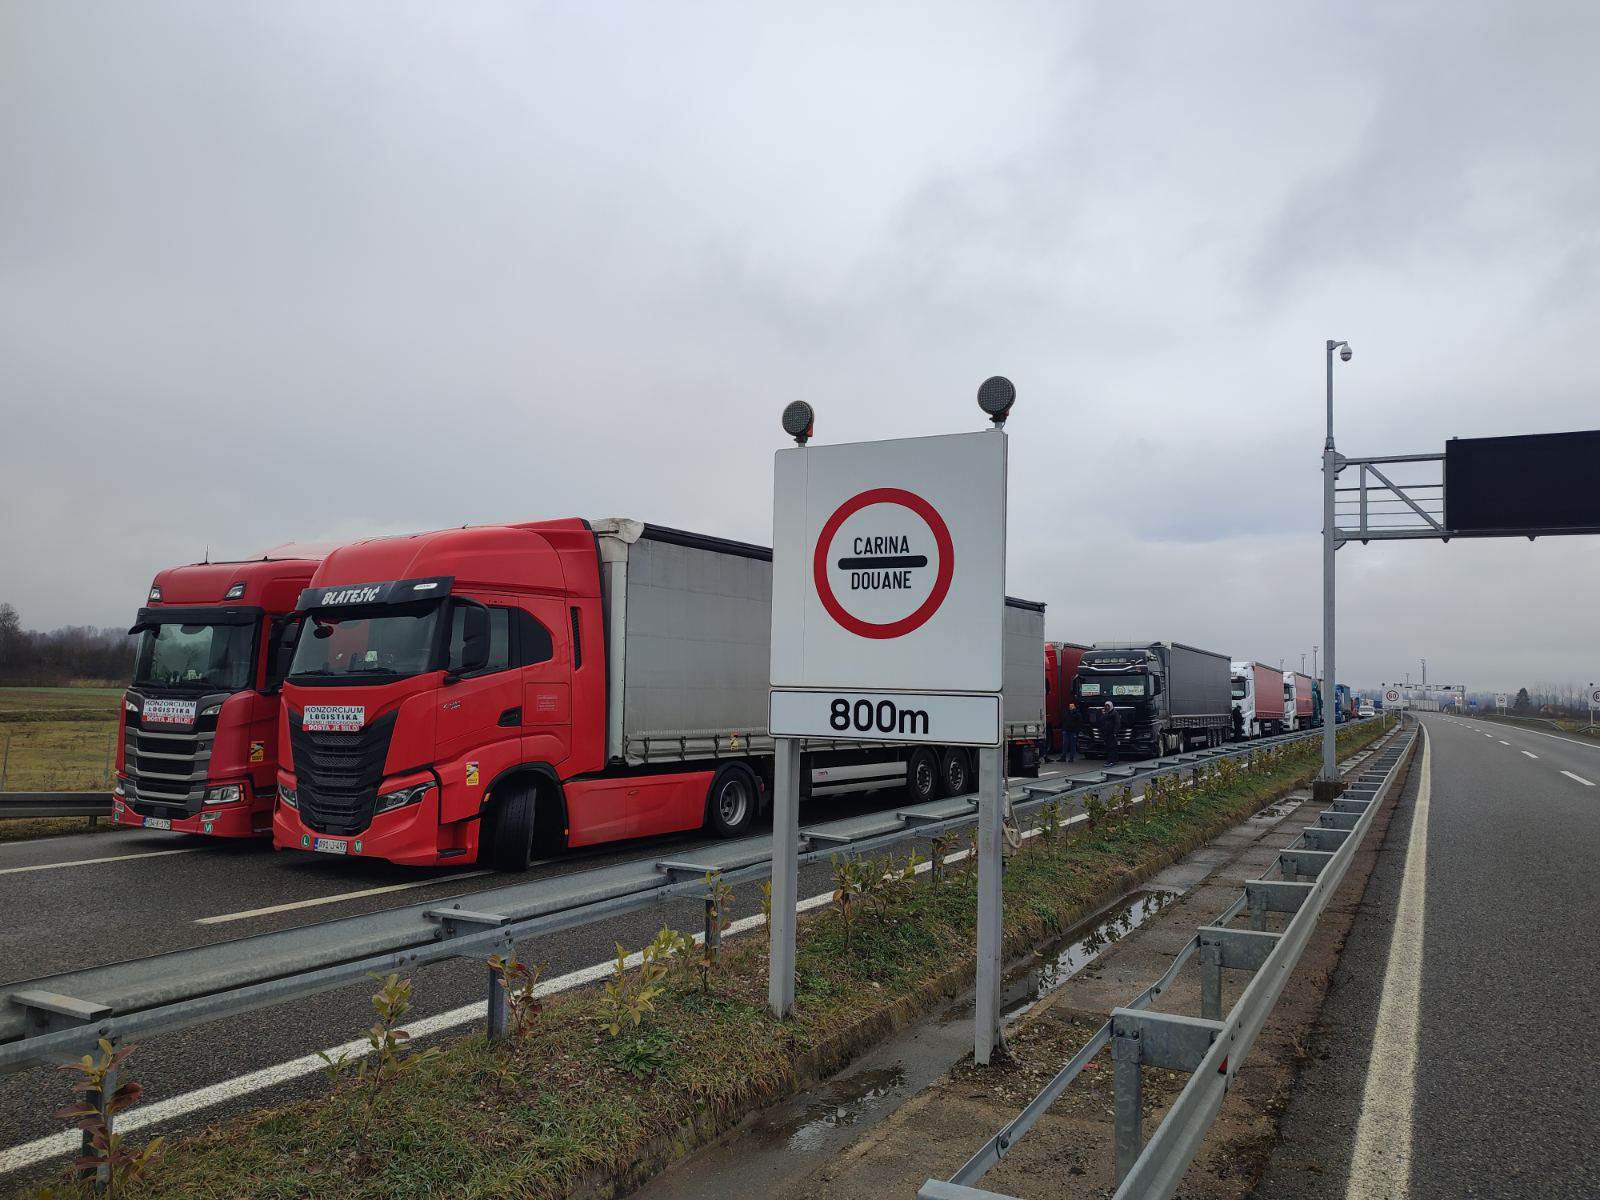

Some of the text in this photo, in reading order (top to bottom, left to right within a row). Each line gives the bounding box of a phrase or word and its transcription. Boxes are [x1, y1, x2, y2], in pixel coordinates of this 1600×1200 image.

[853, 535, 910, 555] CARINA
[850, 570, 912, 590] DOUANE
[321, 585, 381, 605] BLATEŠIĆ
[145, 699, 195, 708] KONZORCIJUM
[829, 698, 929, 734] 800m
